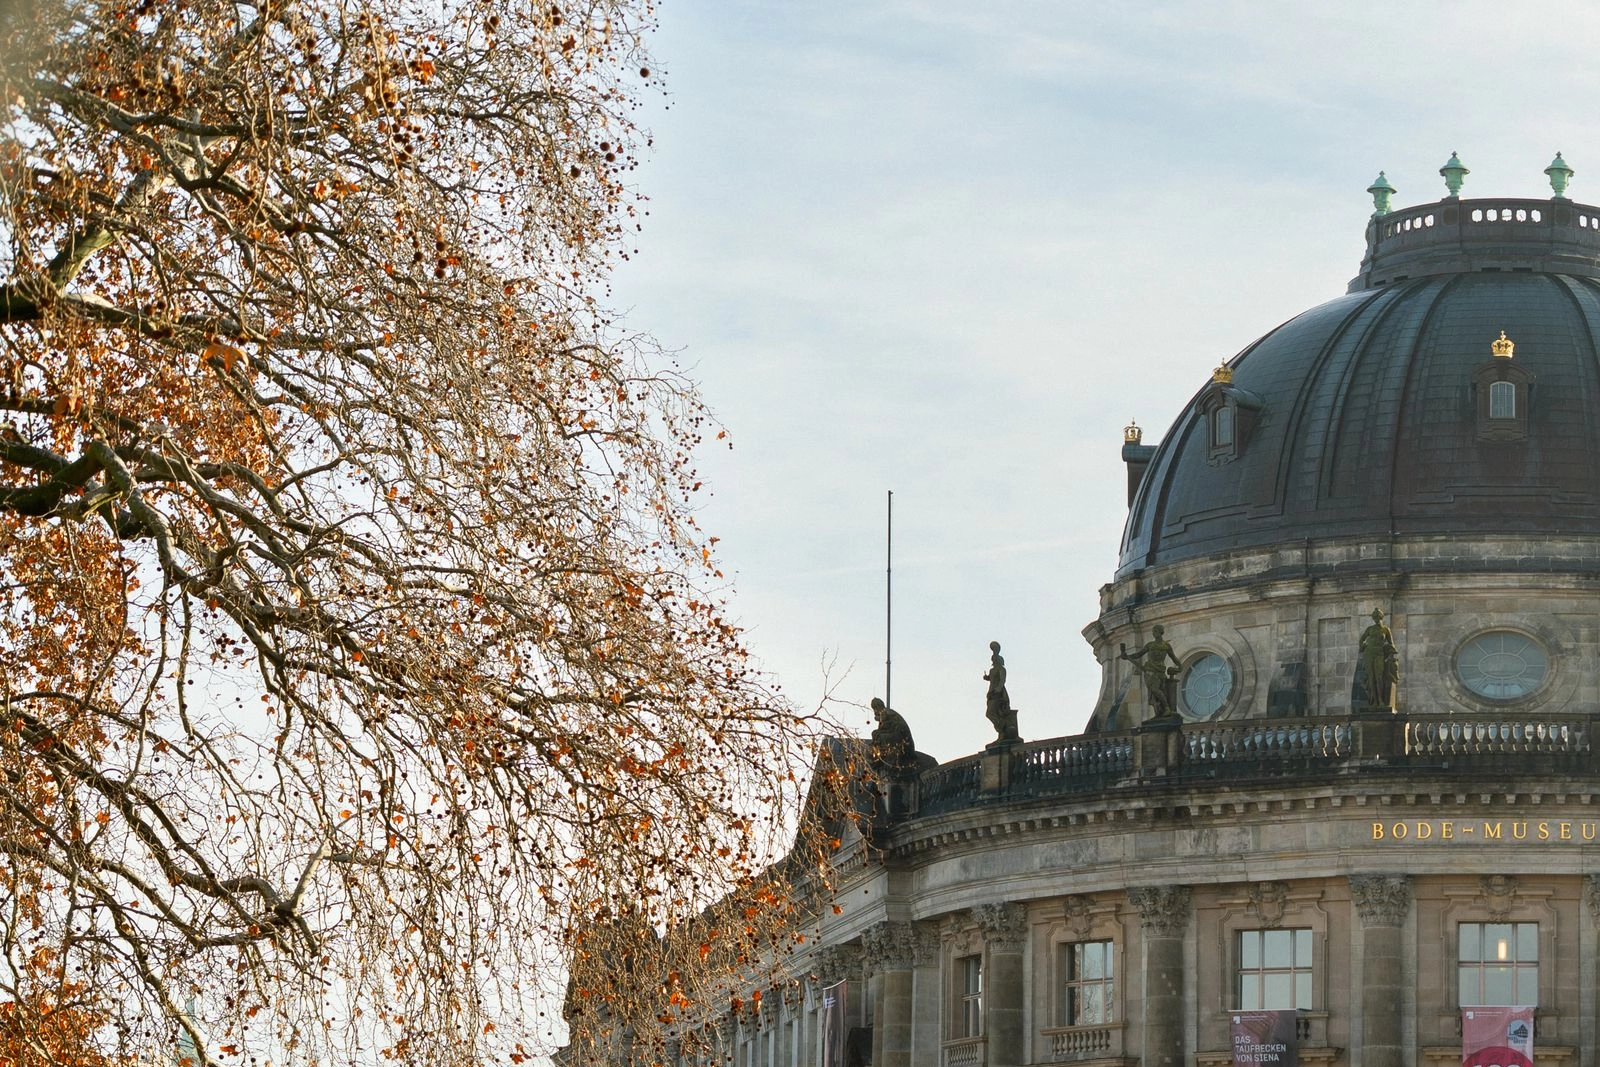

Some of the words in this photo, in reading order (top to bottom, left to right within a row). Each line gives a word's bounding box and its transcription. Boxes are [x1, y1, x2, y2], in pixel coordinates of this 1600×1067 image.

[1235, 1035, 1251, 1044] DAS
[1235, 1044, 1286, 1053] TAUFBECKEN
[1236, 1054, 1252, 1063] VON
[1253, 1053, 1280, 1062] SIENA
